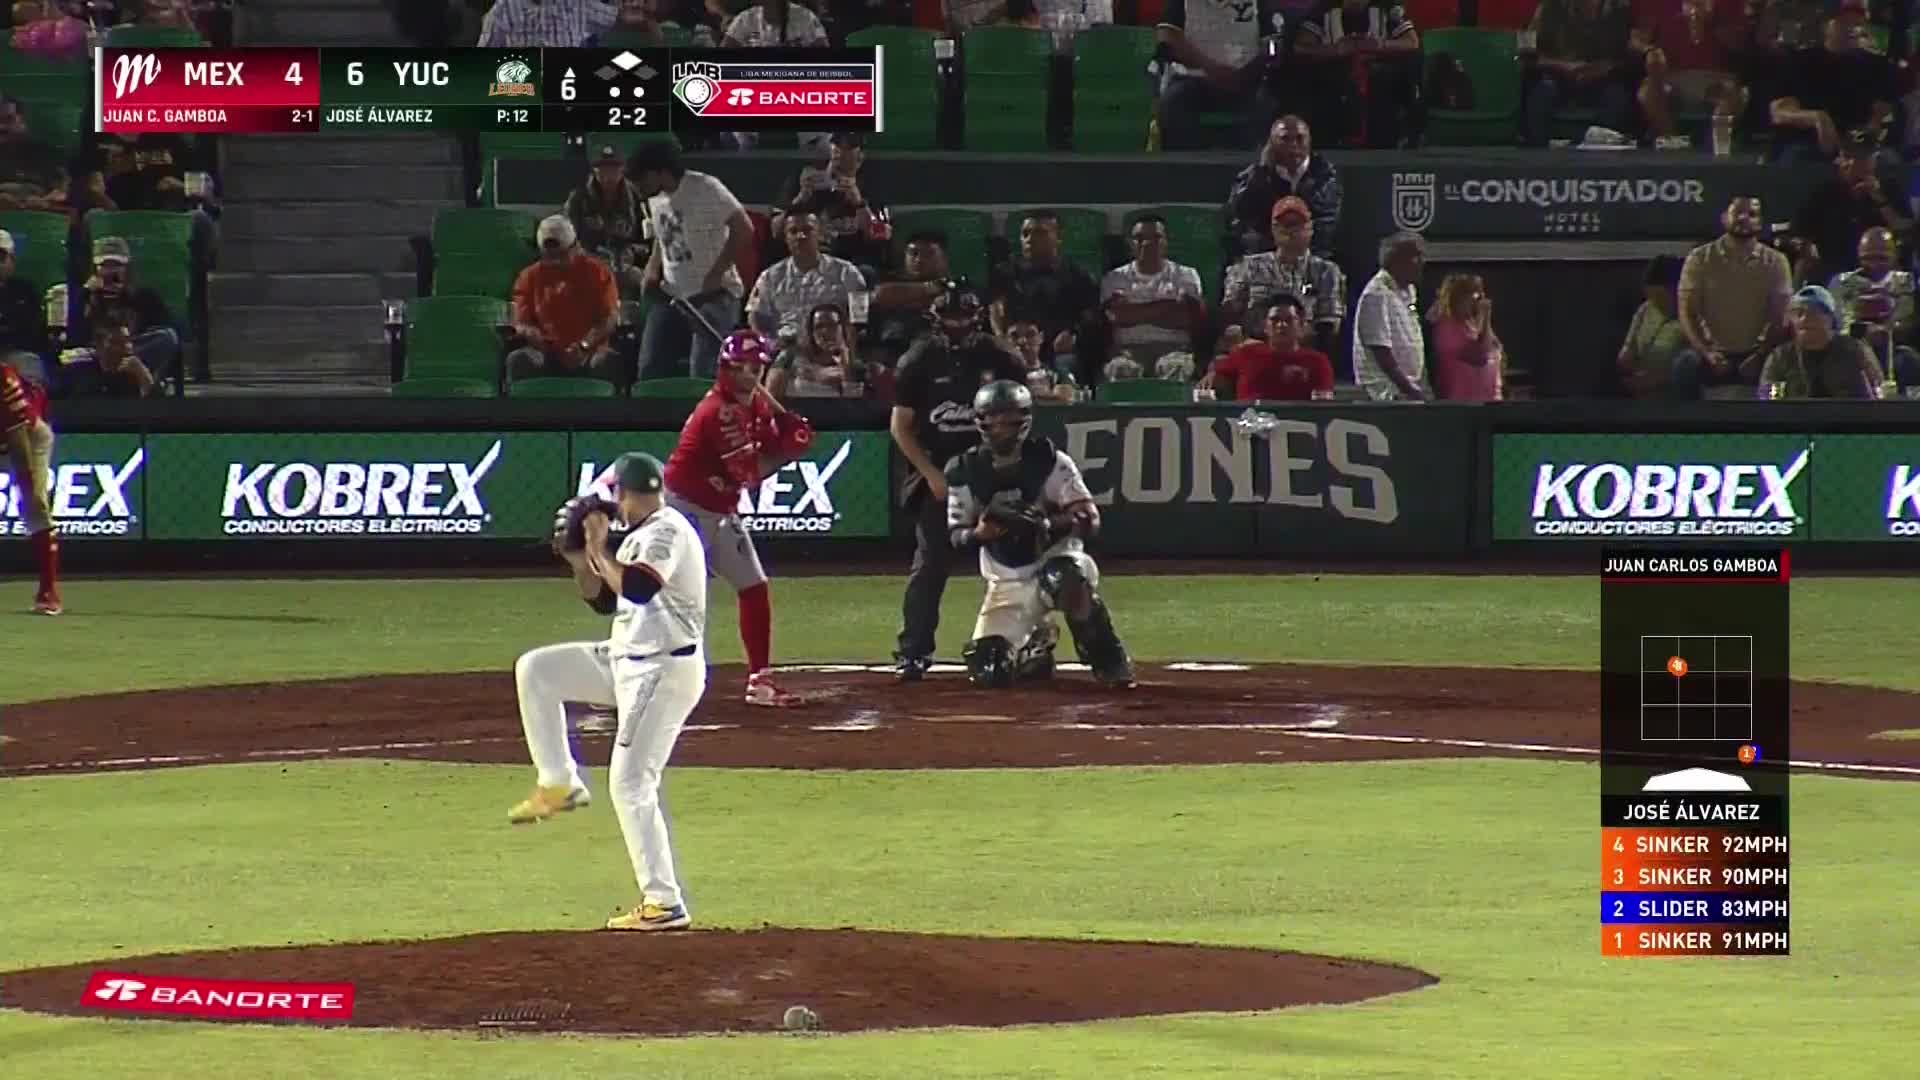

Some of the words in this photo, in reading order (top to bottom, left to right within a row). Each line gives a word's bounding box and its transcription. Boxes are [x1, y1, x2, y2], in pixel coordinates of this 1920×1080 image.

[1462, 179, 1704, 206] CONQUISTADOR
[1544, 211, 1600, 223] HOTEL
[221, 439, 501, 517] KOBREX
[1065, 416, 1398, 524] EONES
[1532, 442, 1814, 518] KOBREX
[223, 518, 364, 534] CONDUCTORES
[367, 516, 481, 534] ELÉCTRICOS
[1535, 520, 1674, 535] CONDUCTORES
[1678, 517, 1794, 536] ELÉCTRICOS
